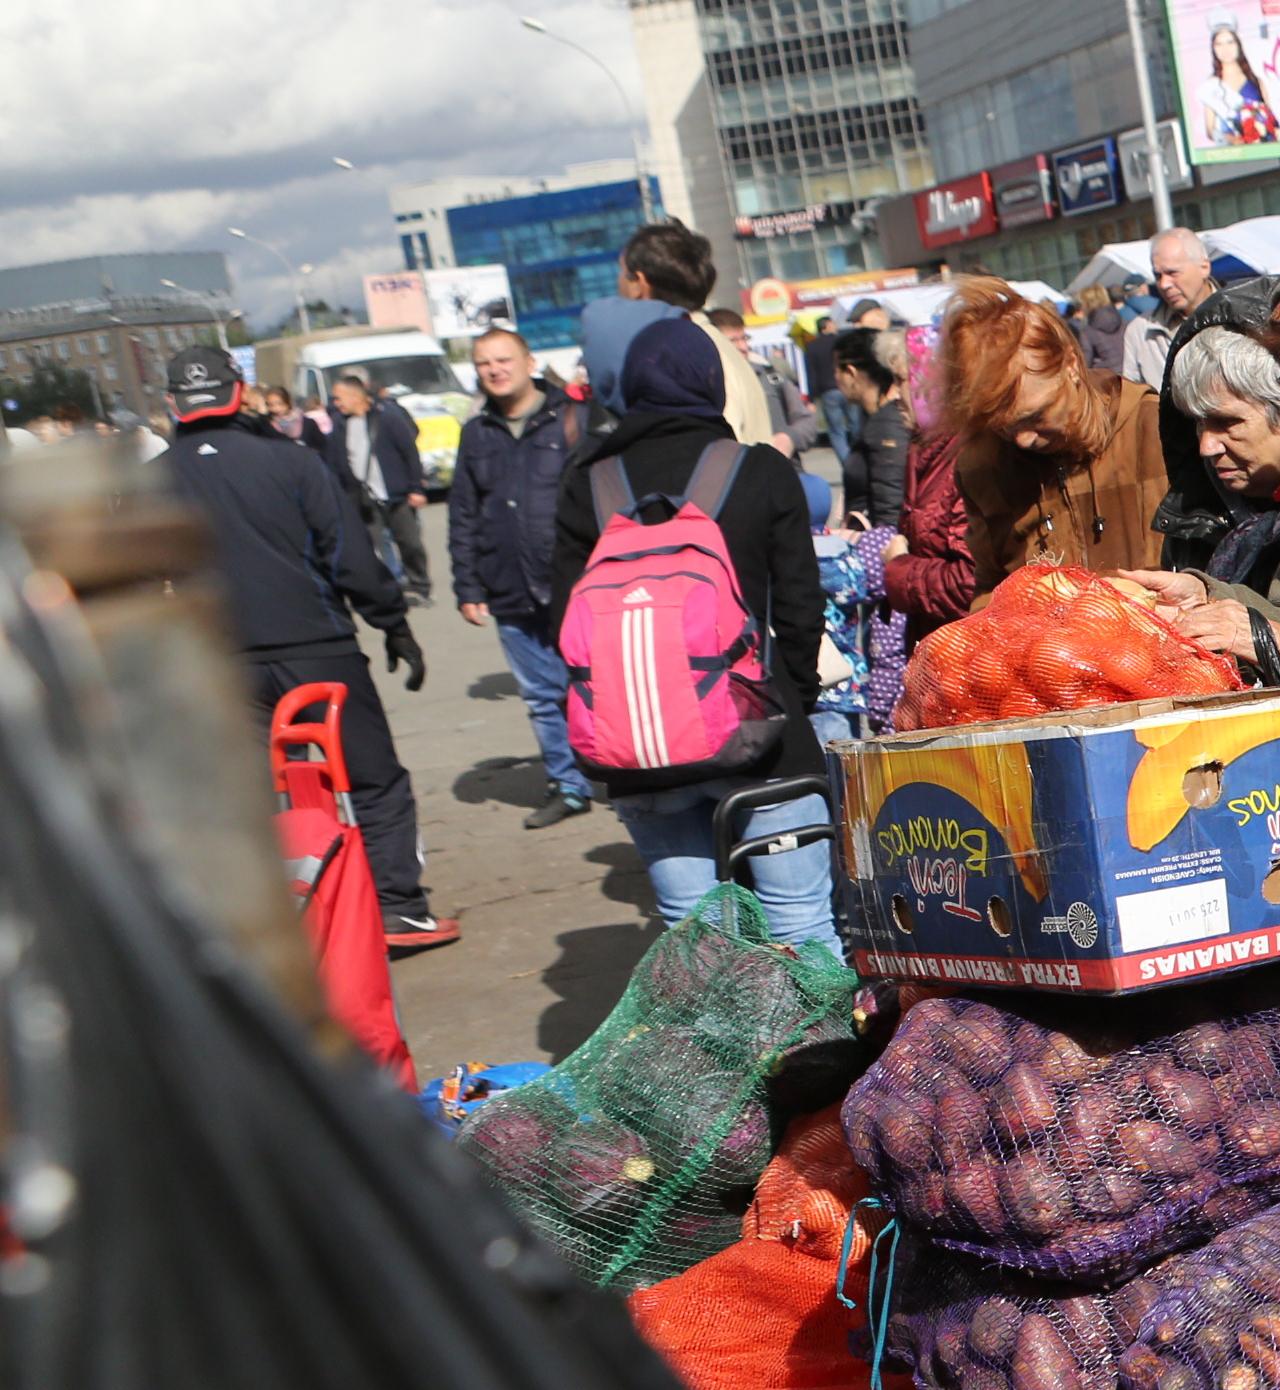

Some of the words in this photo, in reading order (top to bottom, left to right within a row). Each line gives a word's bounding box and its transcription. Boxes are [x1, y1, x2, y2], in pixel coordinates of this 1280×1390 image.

[877, 815, 988, 878] Bananas
[1115, 868, 1147, 880] BANANAS
[1147, 863, 1177, 875] PREMIUM
[1177, 859, 1199, 869] EXTRA
[1151, 869, 1196, 883] CAVENDISH
[907, 855, 982, 922] Tecni
[866, 953, 938, 978] BANANAS
[1139, 934, 1269, 980] BANANAS
[941, 959, 1014, 982] PREMIUM
[1021, 962, 1082, 986] EXTRA
